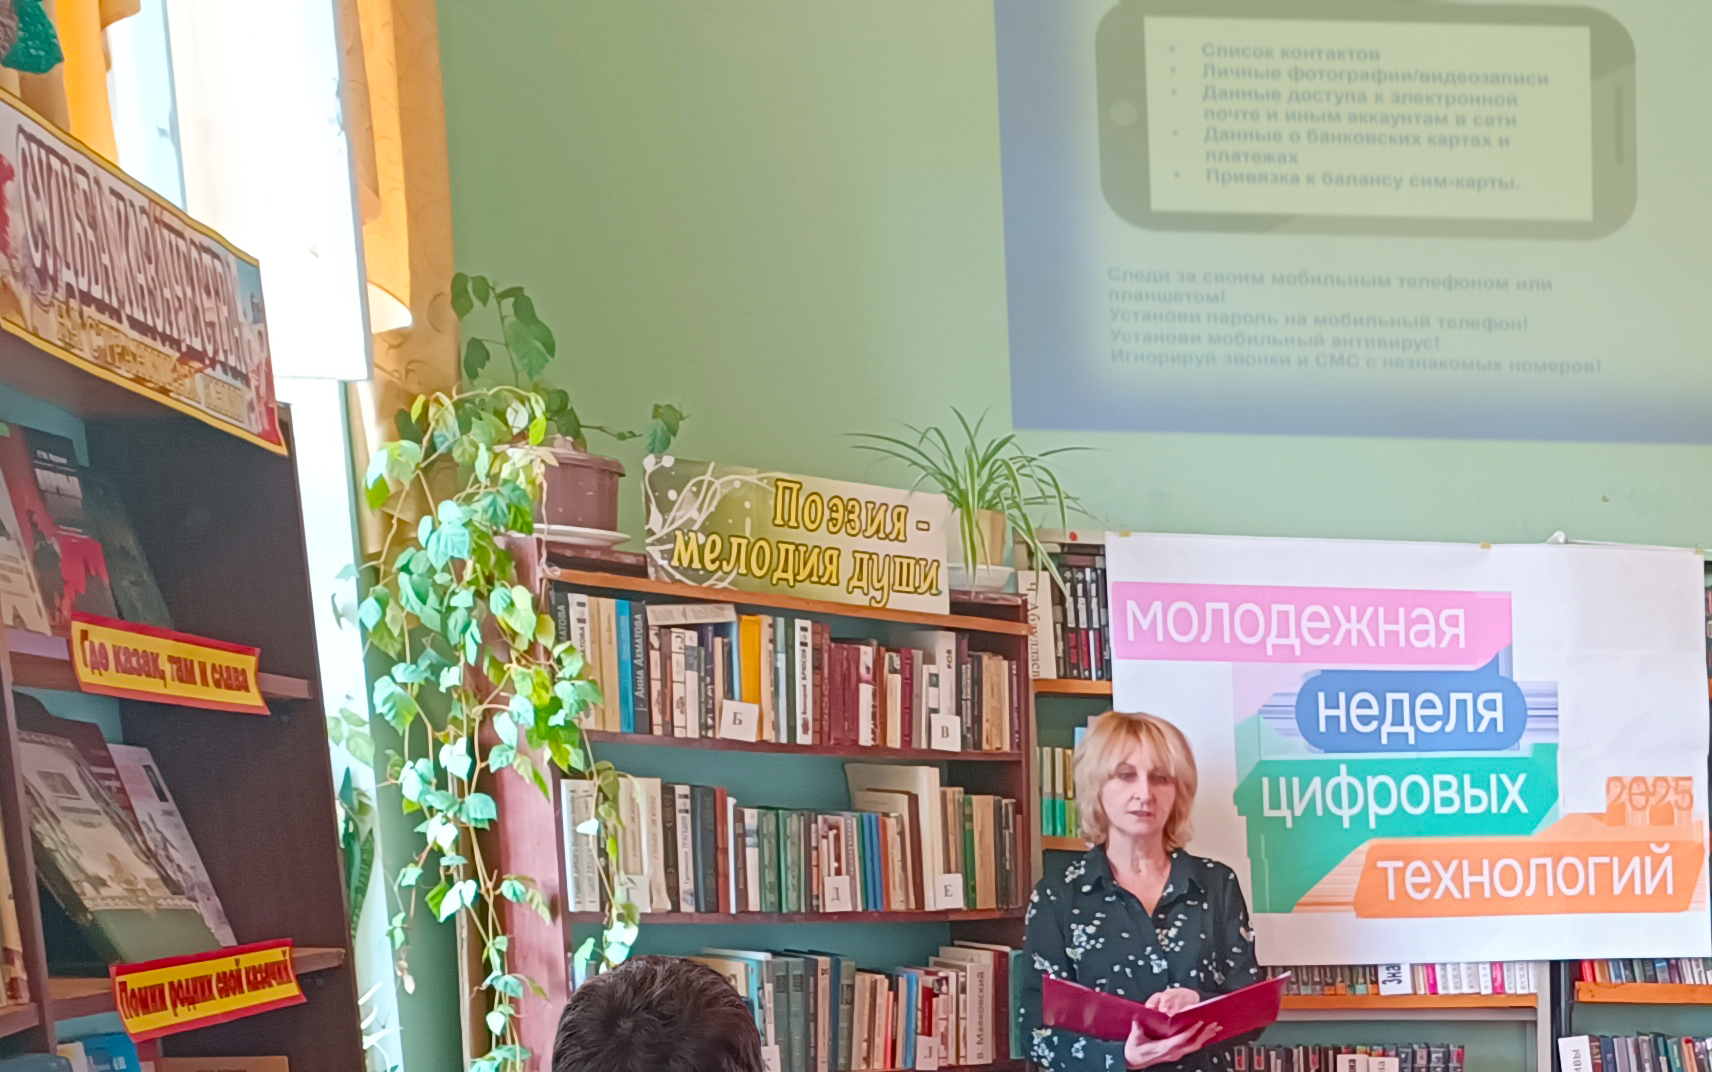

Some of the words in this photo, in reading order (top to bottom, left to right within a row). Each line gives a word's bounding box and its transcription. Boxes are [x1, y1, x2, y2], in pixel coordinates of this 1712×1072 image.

[1202, 42, 1275, 61] Список
[1281, 46, 1380, 61] контактов
[1203, 64, 1281, 80] Личные
[1288, 65, 1549, 87] фотографии/видеозаписи
[1203, 85, 1281, 103] Данные
[1287, 90, 1367, 105] доступа
[1375, 92, 1384, 104] к
[1390, 90, 1517, 109] электронной
[1204, 108, 1260, 123] почте
[1267, 109, 1278, 121] и
[1285, 110, 1342, 124] иным
[1348, 112, 1448, 127] аккаунтам
[1455, 113, 1466, 126] в
[1473, 113, 1517, 127] сети
[1205, 127, 1283, 145] Данные
[1290, 130, 1300, 143] о
[1306, 129, 1421, 147] банковских
[1428, 134, 1491, 150] картах
[1499, 134, 1510, 148] и
[1206, 150, 1299, 165] платежах
[1206, 168, 1299, 185] Привязка
[1306, 172, 1315, 185] к
[1322, 171, 1402, 190] балансу
[1409, 175, 1520, 192] сим-карты.
[17, 123, 121, 312] СУДЬБА
[109, 186, 250, 381] КАЗАЧЕСТВА
[1107, 267, 1170, 284] Следи
[1177, 271, 1195, 284] за
[1203, 271, 1264, 285] своим
[1271, 269, 1390, 288] мобильным
[1397, 276, 1509, 292] телефоном
[1515, 277, 1553, 292] или
[1108, 290, 1225, 305] планшетом!
[1108, 308, 1200, 324] Установи
[1207, 311, 1278, 327] пароль
[1285, 314, 1307, 326] на
[1314, 311, 1430, 329] мобильный
[1437, 317, 1528, 333] телефон!
[1110, 329, 1201, 345] Установи
[1208, 332, 1324, 348] мобильный
[1332, 335, 1439, 353] антивирус!
[1111, 349, 1216, 368] Игнорируй
[1222, 352, 1290, 367] звонки
[1297, 354, 1308, 367] и
[1315, 353, 1359, 369] СМС
[1366, 356, 1376, 369] с
[1383, 355, 1502, 372] незнакомых
[1509, 359, 1601, 377] номеров!
[772, 478, 910, 543] Поэзия
[671, 530, 840, 588] мелодия
[848, 550, 941, 607] души
[633, 613, 645, 666] АХМАТОВА
[1027, 603, 1041, 678] Абуллаев
[1125, 598, 1466, 656] молодежная
[80, 629, 110, 677] Где
[111, 643, 168, 688] казак,
[167, 655, 197, 686] там
[198, 660, 210, 688] и
[210, 662, 251, 693] слава
[1317, 689, 1505, 745] неделя
[1261, 763, 1529, 830] цифровых
[1605, 776, 1695, 812] 2025
[1376, 843, 1675, 901] технологий
[118, 980, 168, 1020] Помни
[216, 957, 245, 1000] свой
[244, 949, 293, 992] казачий
[972, 971, 985, 1045] Маяковский
